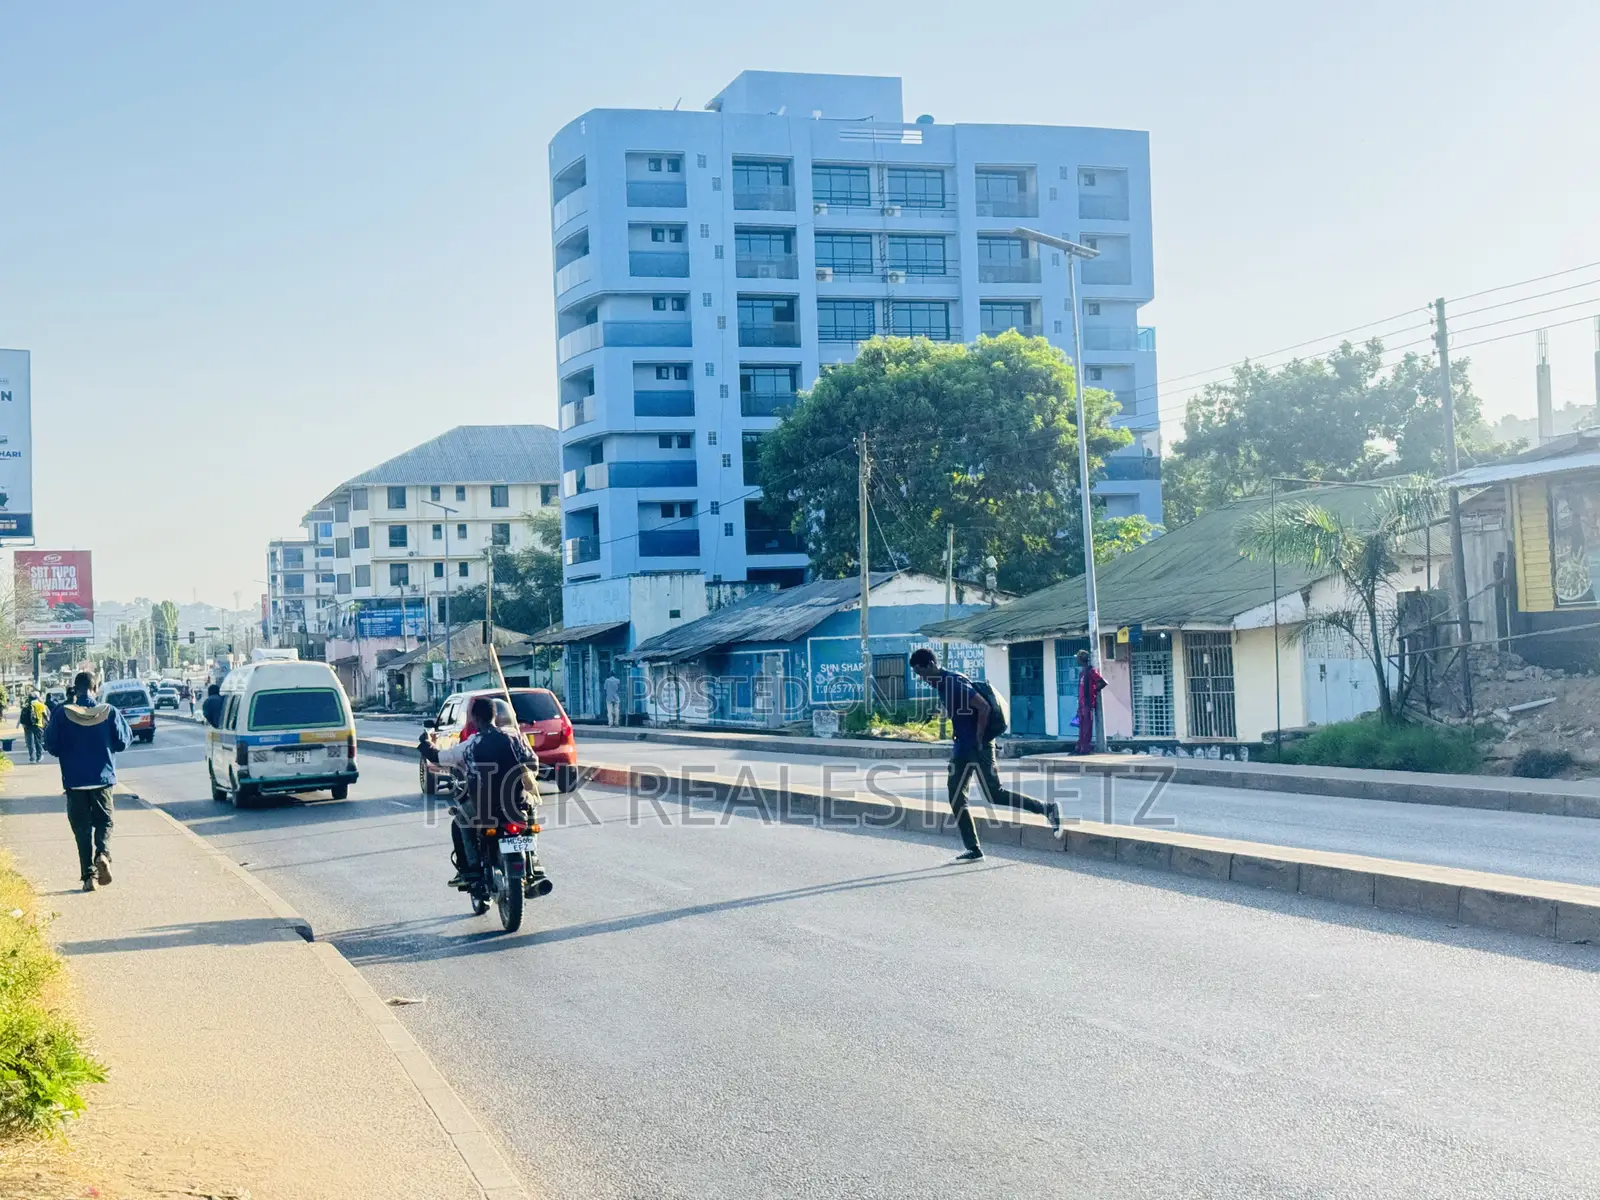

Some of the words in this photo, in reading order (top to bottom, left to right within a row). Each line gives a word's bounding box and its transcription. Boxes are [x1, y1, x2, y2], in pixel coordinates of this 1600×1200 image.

[52, 566, 76, 578] TUPO
[31, 578, 77, 590] MWANZA
[820, 663, 839, 673] SUN
